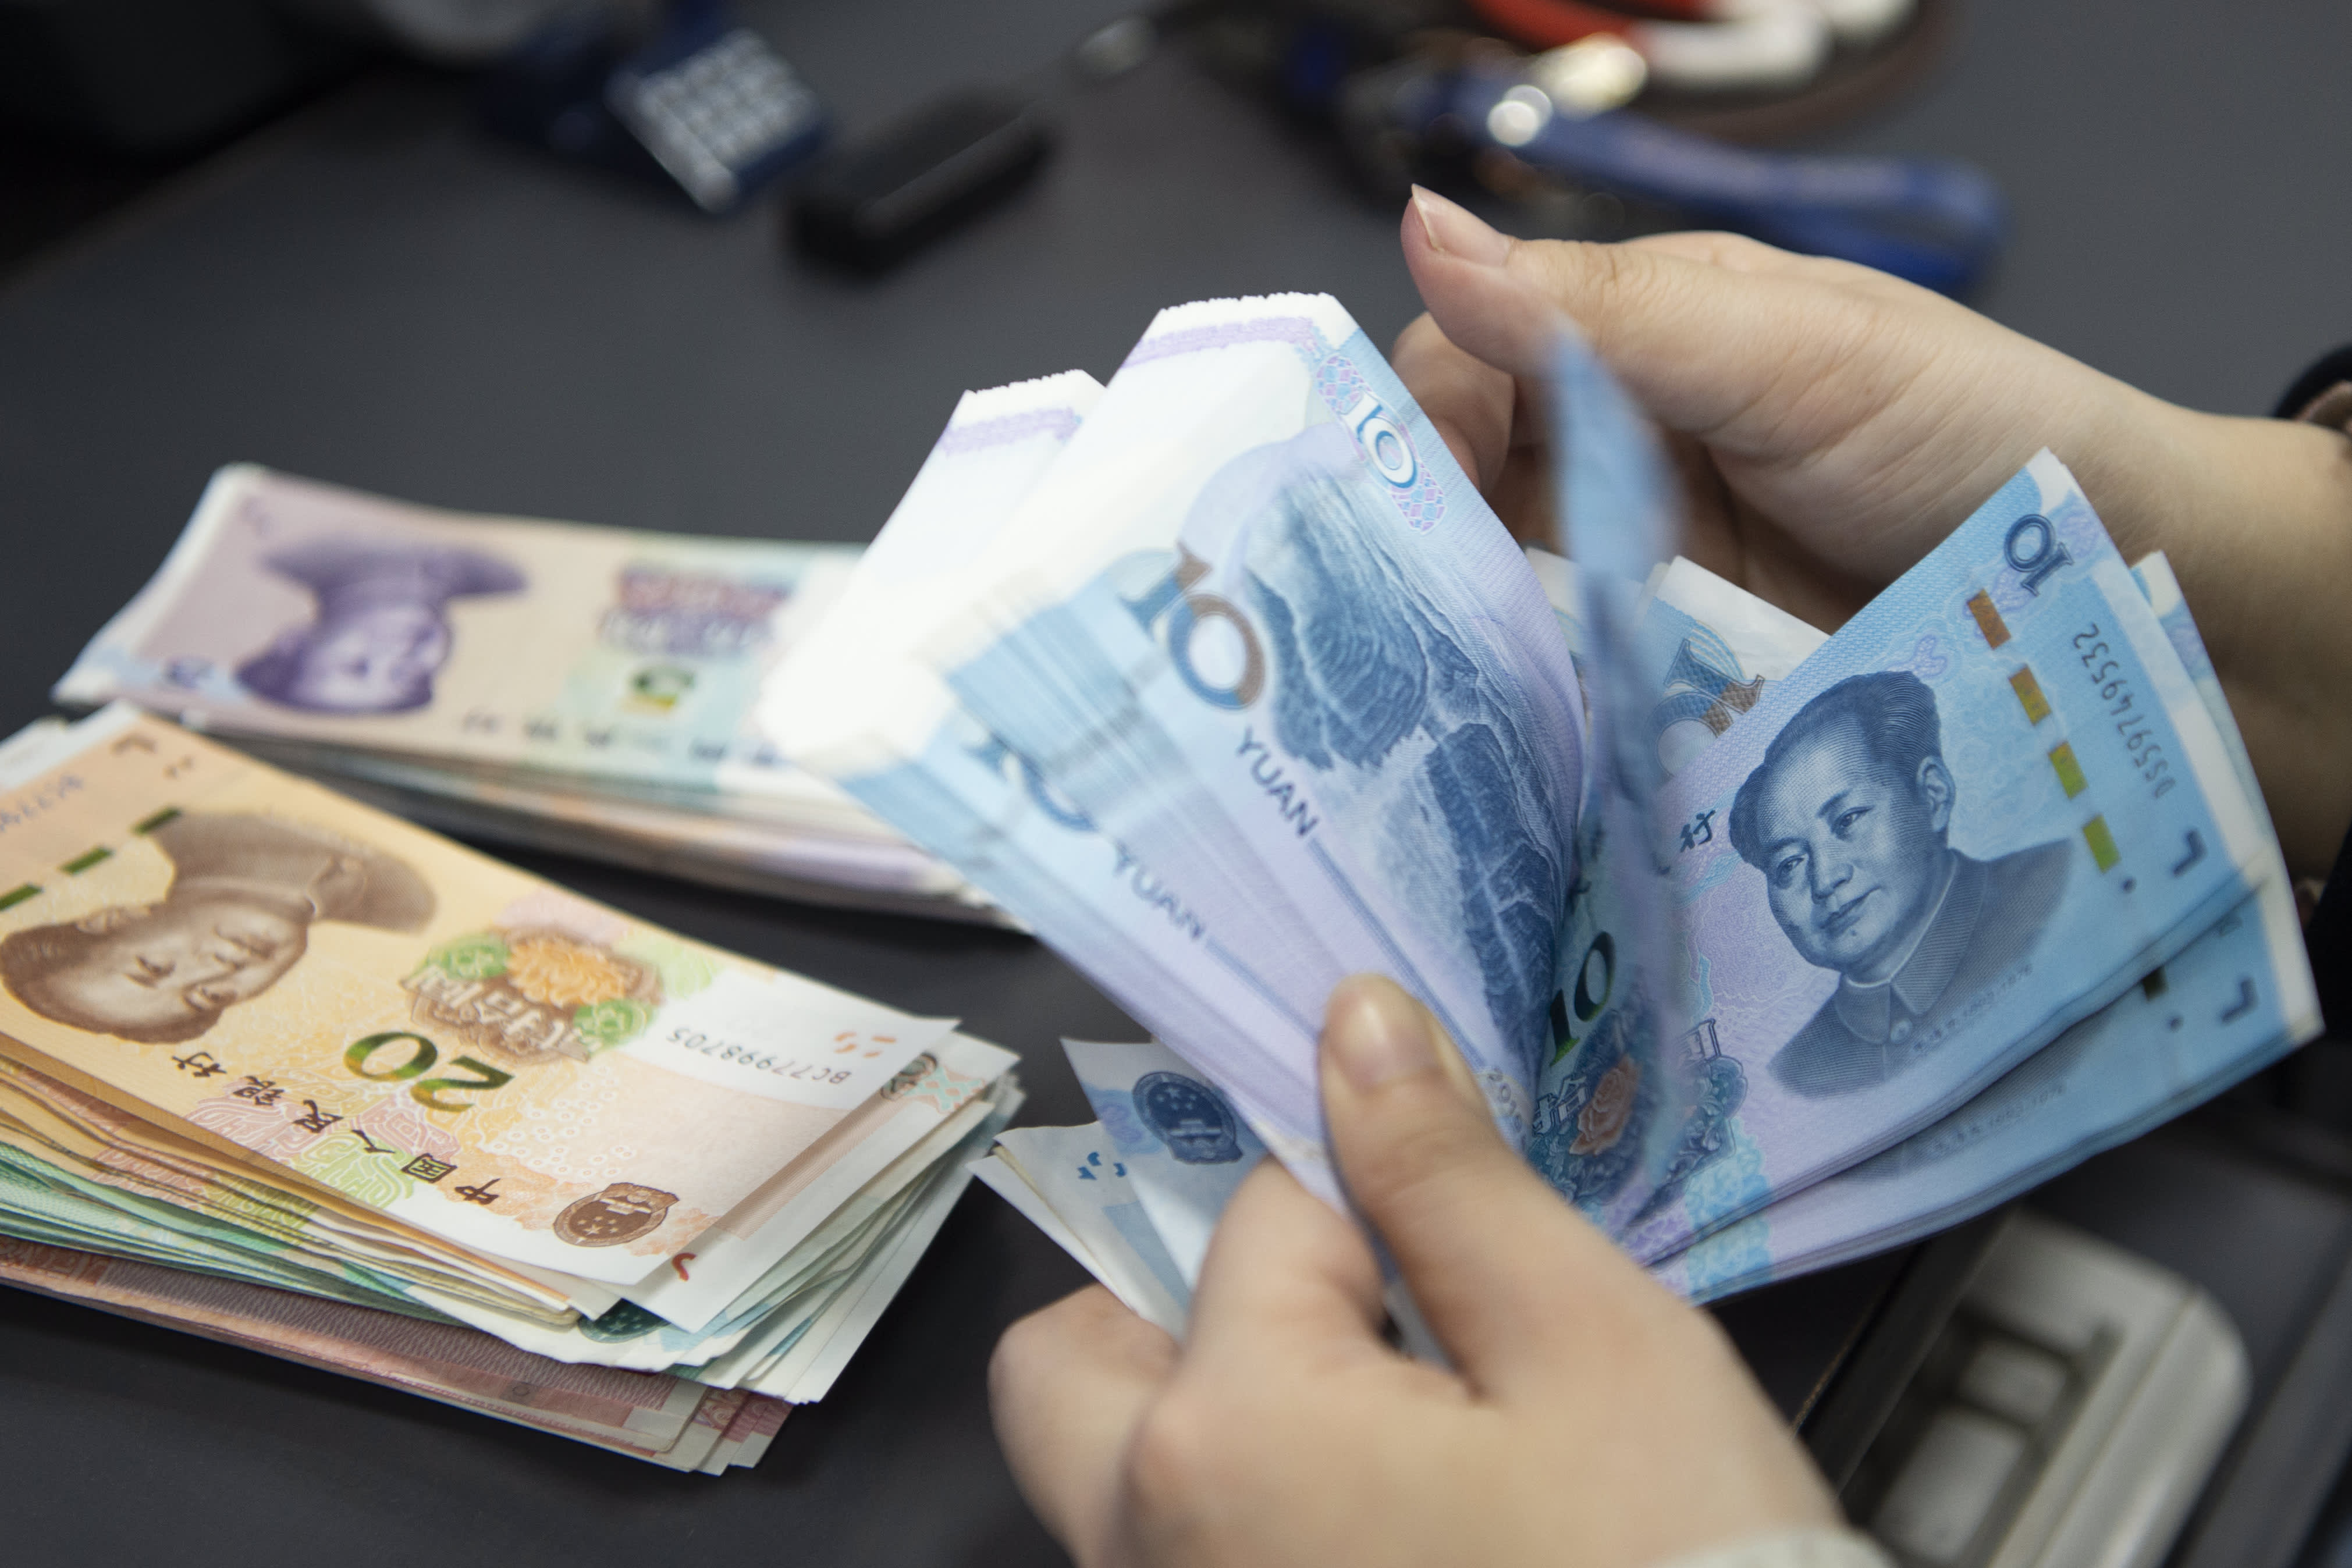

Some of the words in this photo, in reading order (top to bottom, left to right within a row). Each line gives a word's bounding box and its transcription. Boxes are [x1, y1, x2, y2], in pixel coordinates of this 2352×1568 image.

[1340, 389, 1419, 489] 10
[2003, 513, 2074, 596] 10
[1116, 536, 1267, 712] 10
[1237, 726, 1319, 838] YUAN
[1114, 840, 1204, 941] YUAN
[1549, 931, 1616, 1067] 10
[343, 1031, 515, 1112] 20
